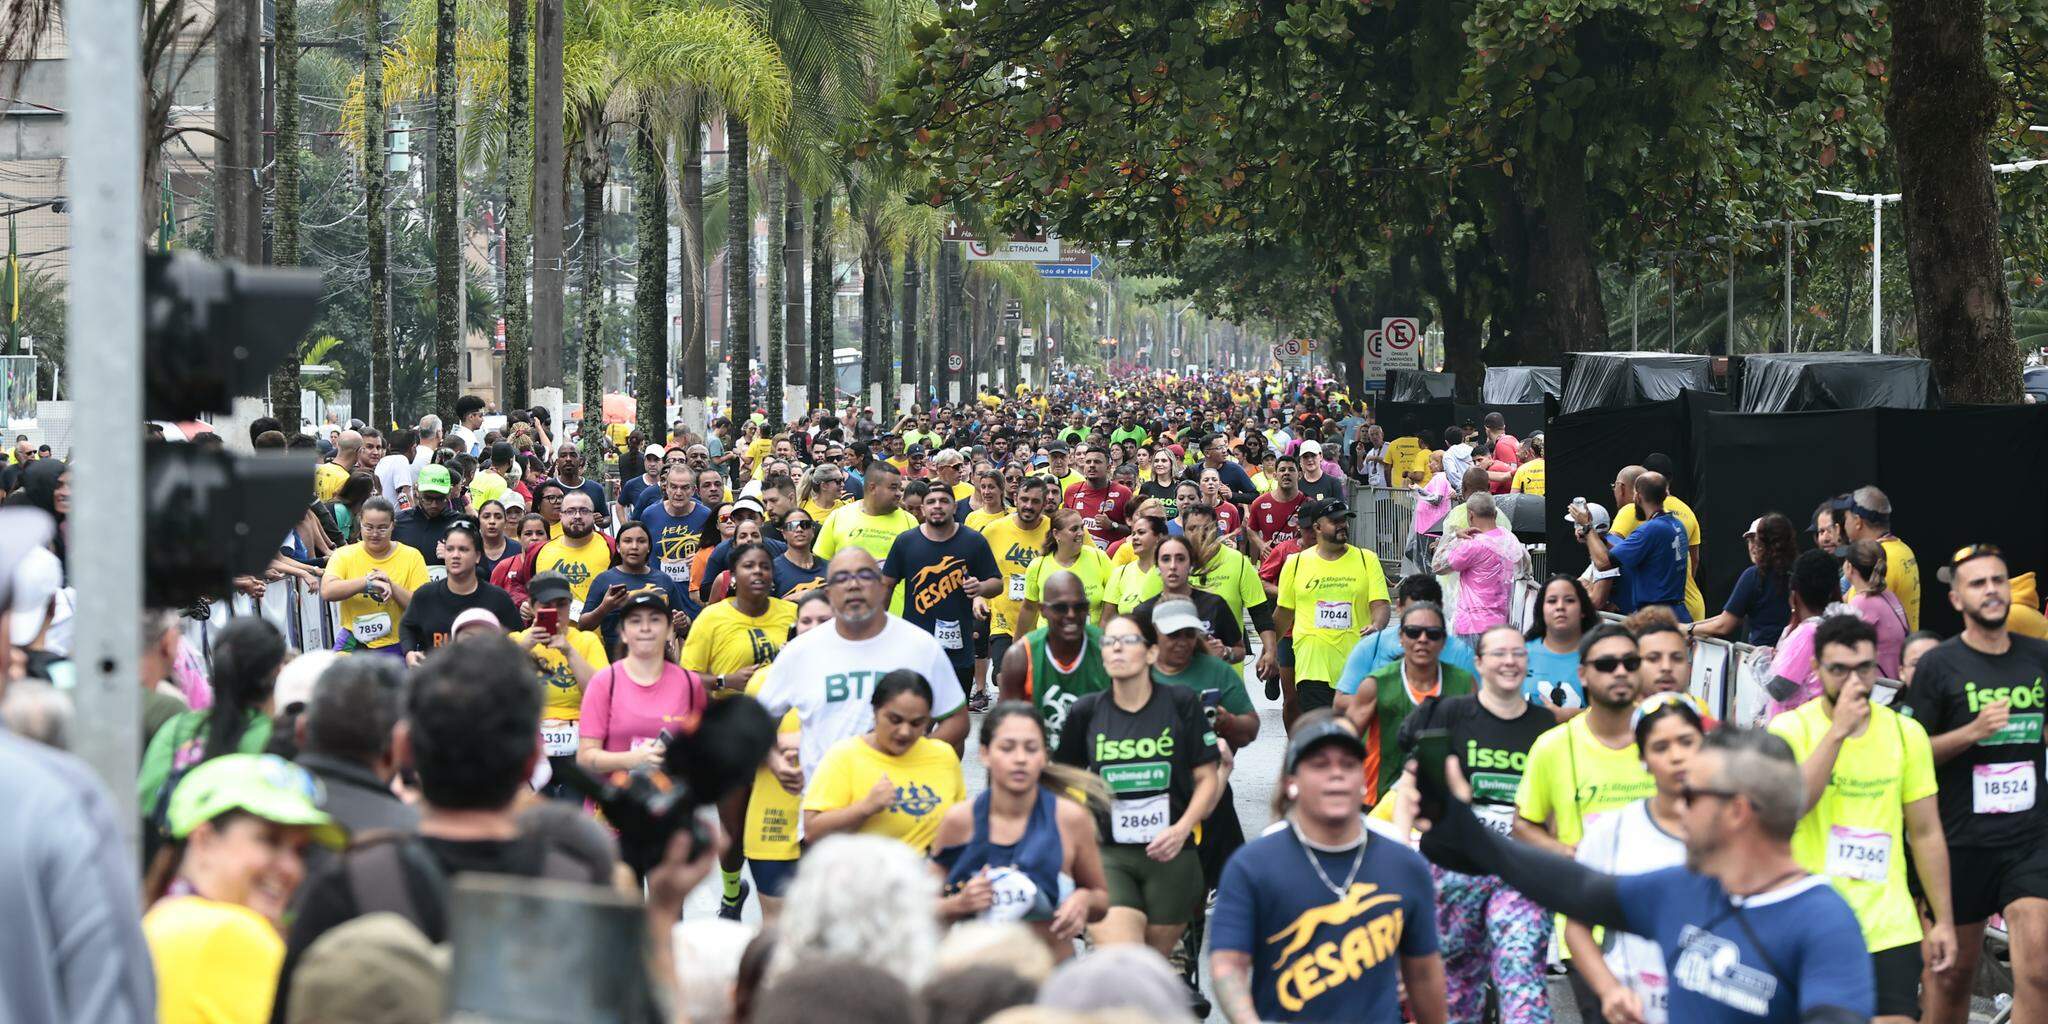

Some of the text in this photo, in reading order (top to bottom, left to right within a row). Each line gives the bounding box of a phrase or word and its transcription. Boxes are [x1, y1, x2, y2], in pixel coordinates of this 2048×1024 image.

[949, 357, 961, 366] 50
[664, 566, 686, 574] 19614
[914, 568, 966, 615] CESAR
[1013, 583, 1025, 591] 23
[1320, 611, 1348, 619] 17044
[359, 623, 383, 634] 7859
[938, 629, 960, 640] 2593
[542, 733, 572, 744] 3317
[1095, 726, 1174, 761] issoé
[1467, 739, 1527, 771] isso
[1107, 769, 1151, 782] Unimed
[1984, 780, 2029, 795] 18524
[1120, 812, 1163, 828] 28661
[1839, 844, 1885, 863] 17360
